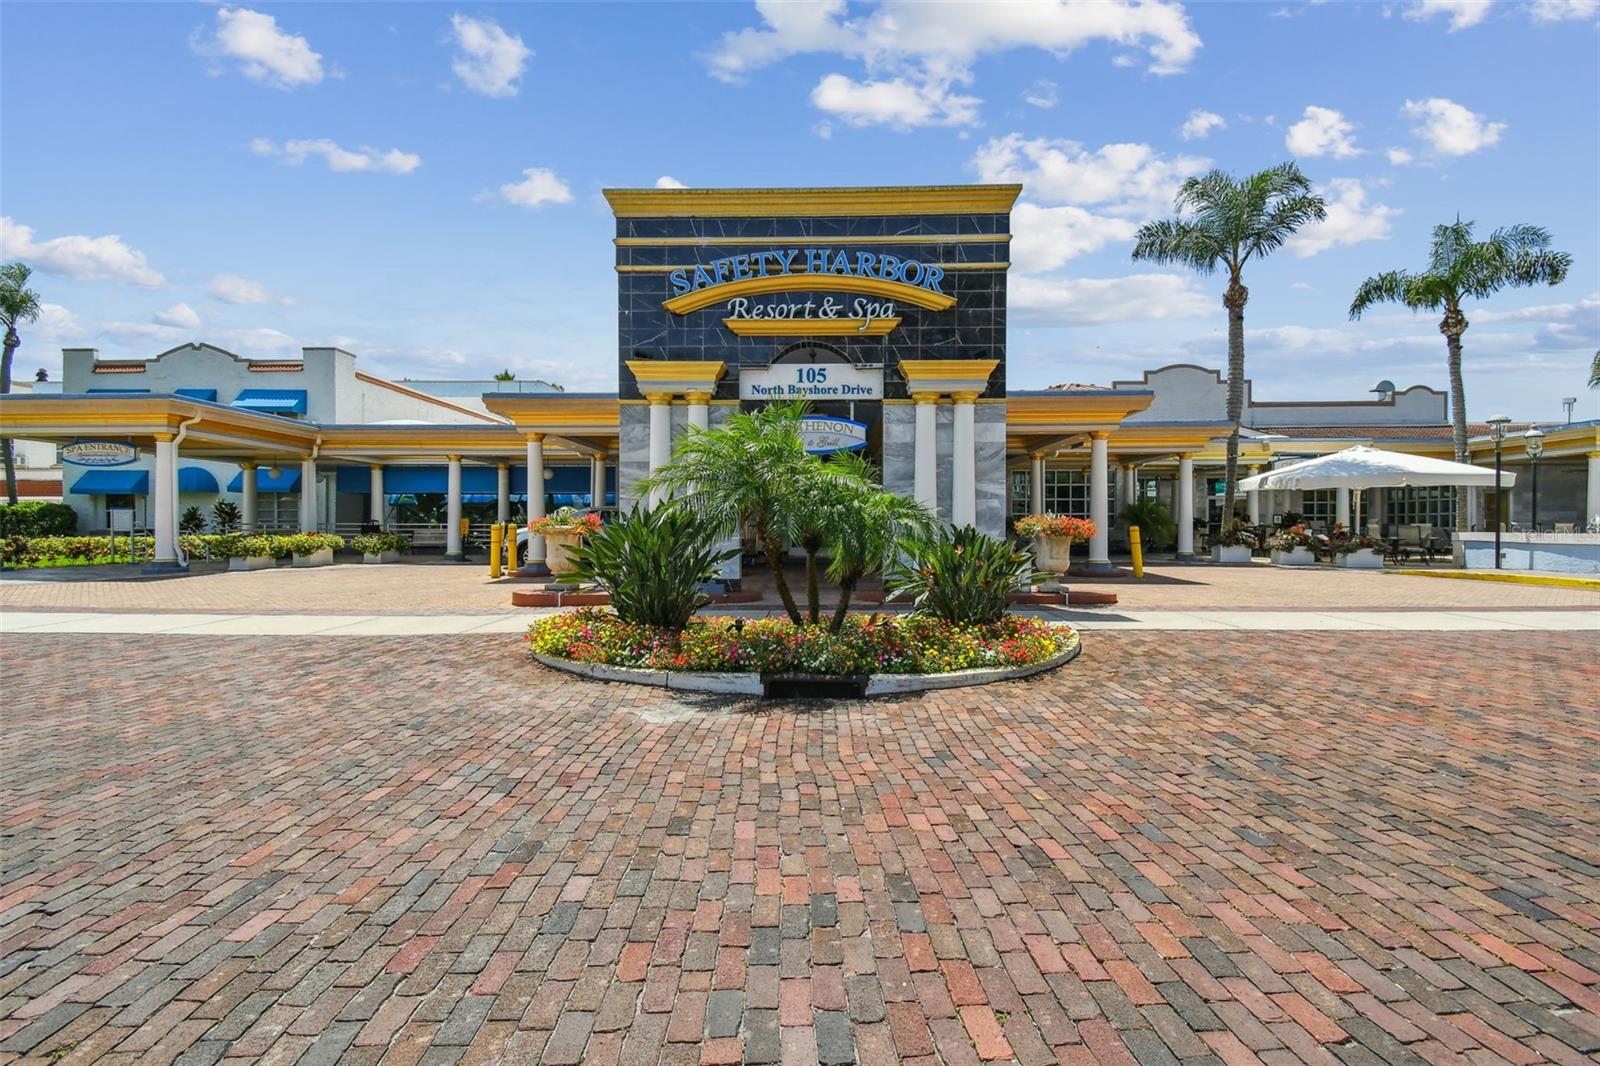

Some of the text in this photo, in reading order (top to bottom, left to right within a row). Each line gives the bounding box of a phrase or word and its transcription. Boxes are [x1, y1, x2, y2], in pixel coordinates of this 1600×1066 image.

[669, 249, 945, 296] SAFETY HARBOR
[727, 297, 896, 333] Resort & Spa
[796, 367, 827, 383] 105
[751, 384, 873, 397] North Bayshore Drive
[66, 445, 83, 454] SPA
[84, 443, 132, 455] ENTRANCE
[816, 436, 840, 448] Grill
